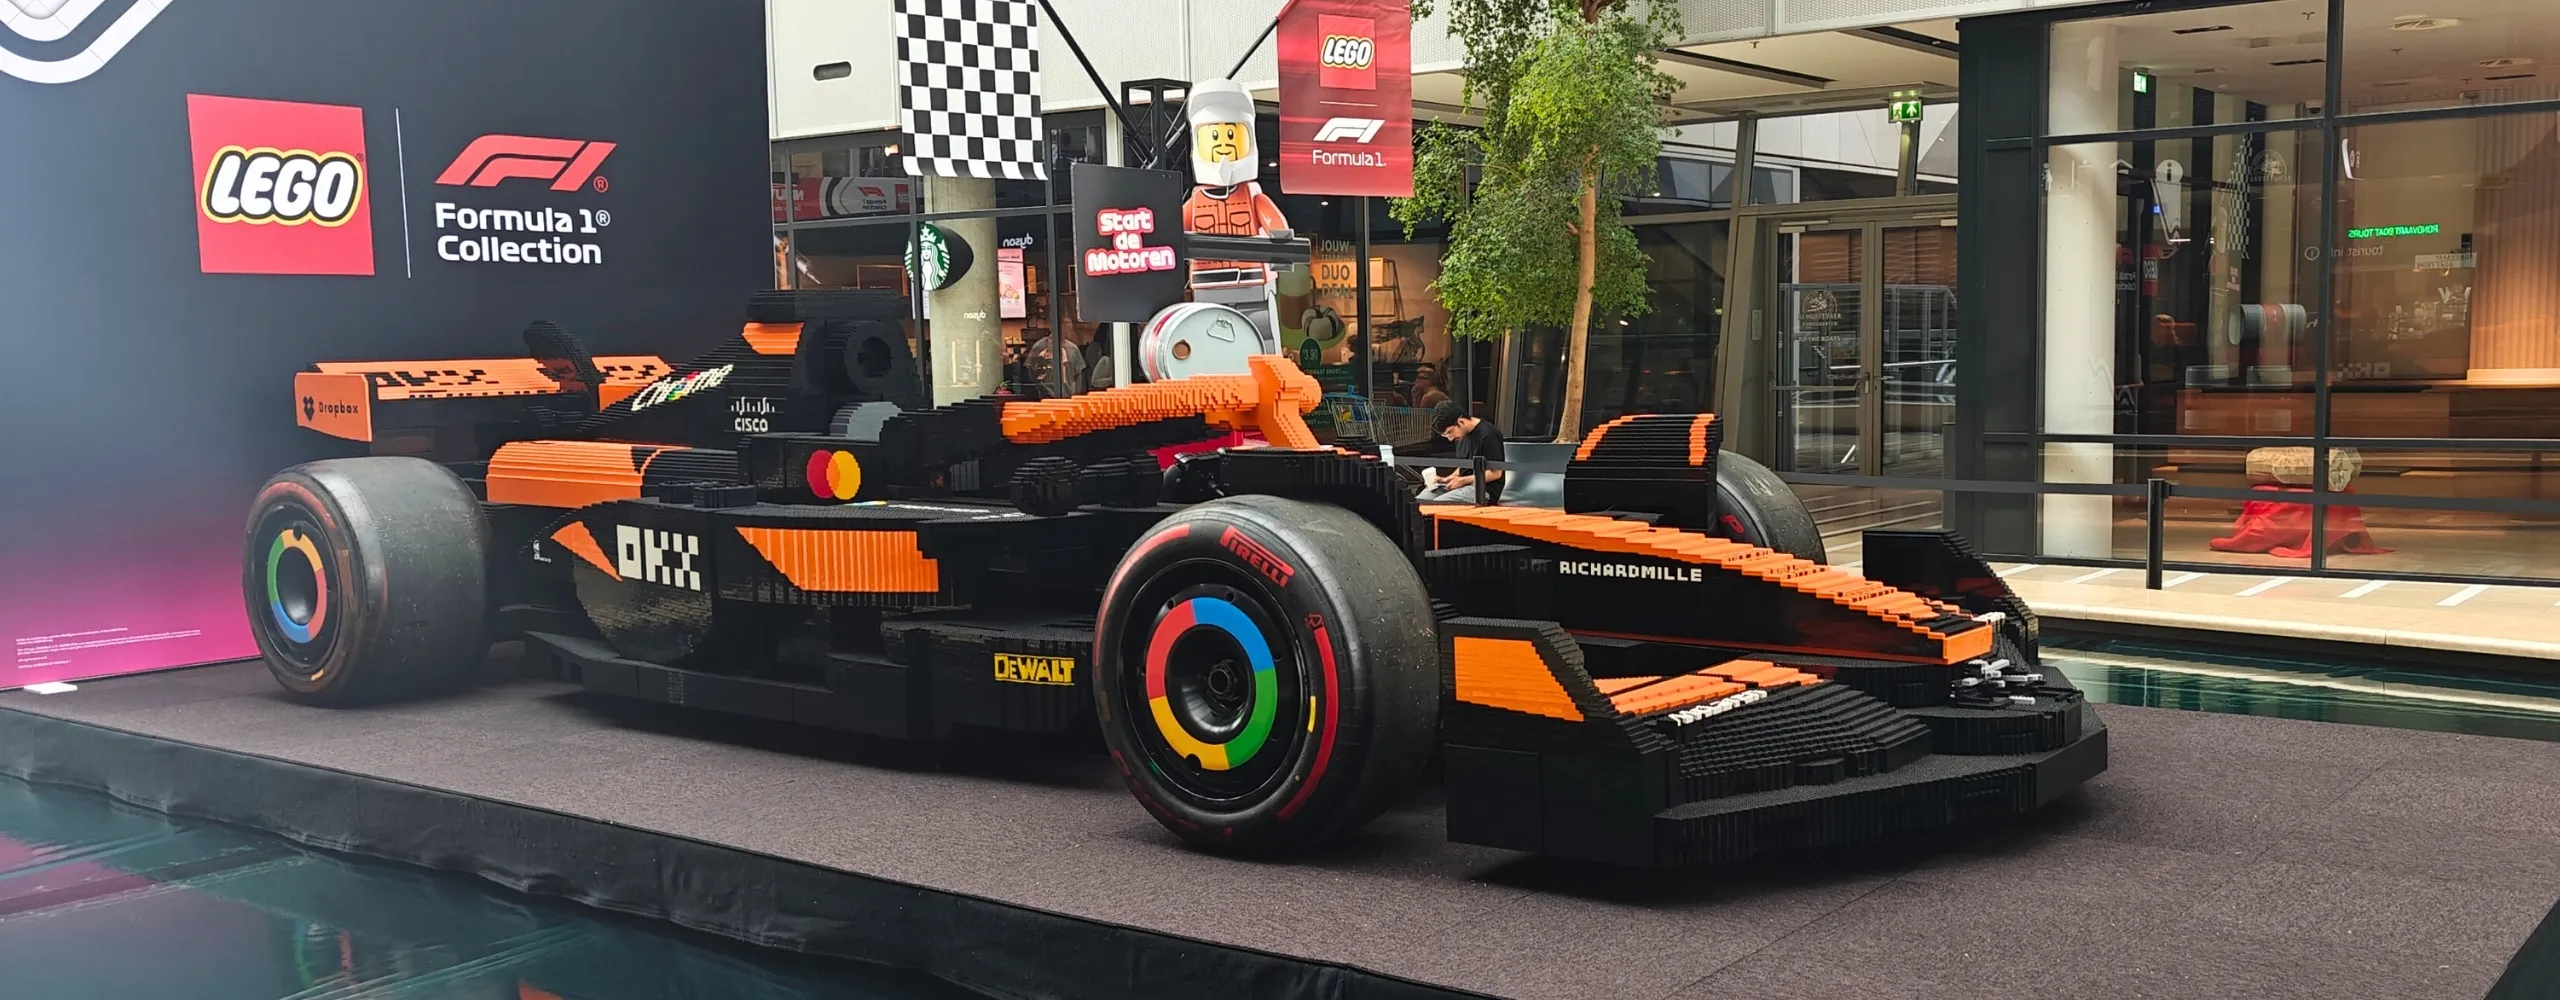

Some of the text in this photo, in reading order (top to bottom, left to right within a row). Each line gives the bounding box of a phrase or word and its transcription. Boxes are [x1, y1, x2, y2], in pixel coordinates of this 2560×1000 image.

[1322, 36, 1373, 68] LEGO
[207, 150, 358, 219] LEGO
[435, 202, 573, 233] Formula
[1100, 211, 1152, 232] Start
[438, 235, 602, 264] Collection
[1115, 231, 1140, 250] de
[1321, 239, 1350, 252] JOUW
[1087, 250, 1174, 272] Motoren
[1321, 264, 1350, 280] DUO
[318, 400, 359, 418] Dropbox
[734, 417, 769, 432] CISCO
[616, 524, 701, 592] OKX
[1220, 524, 1296, 588] PIRELLI
